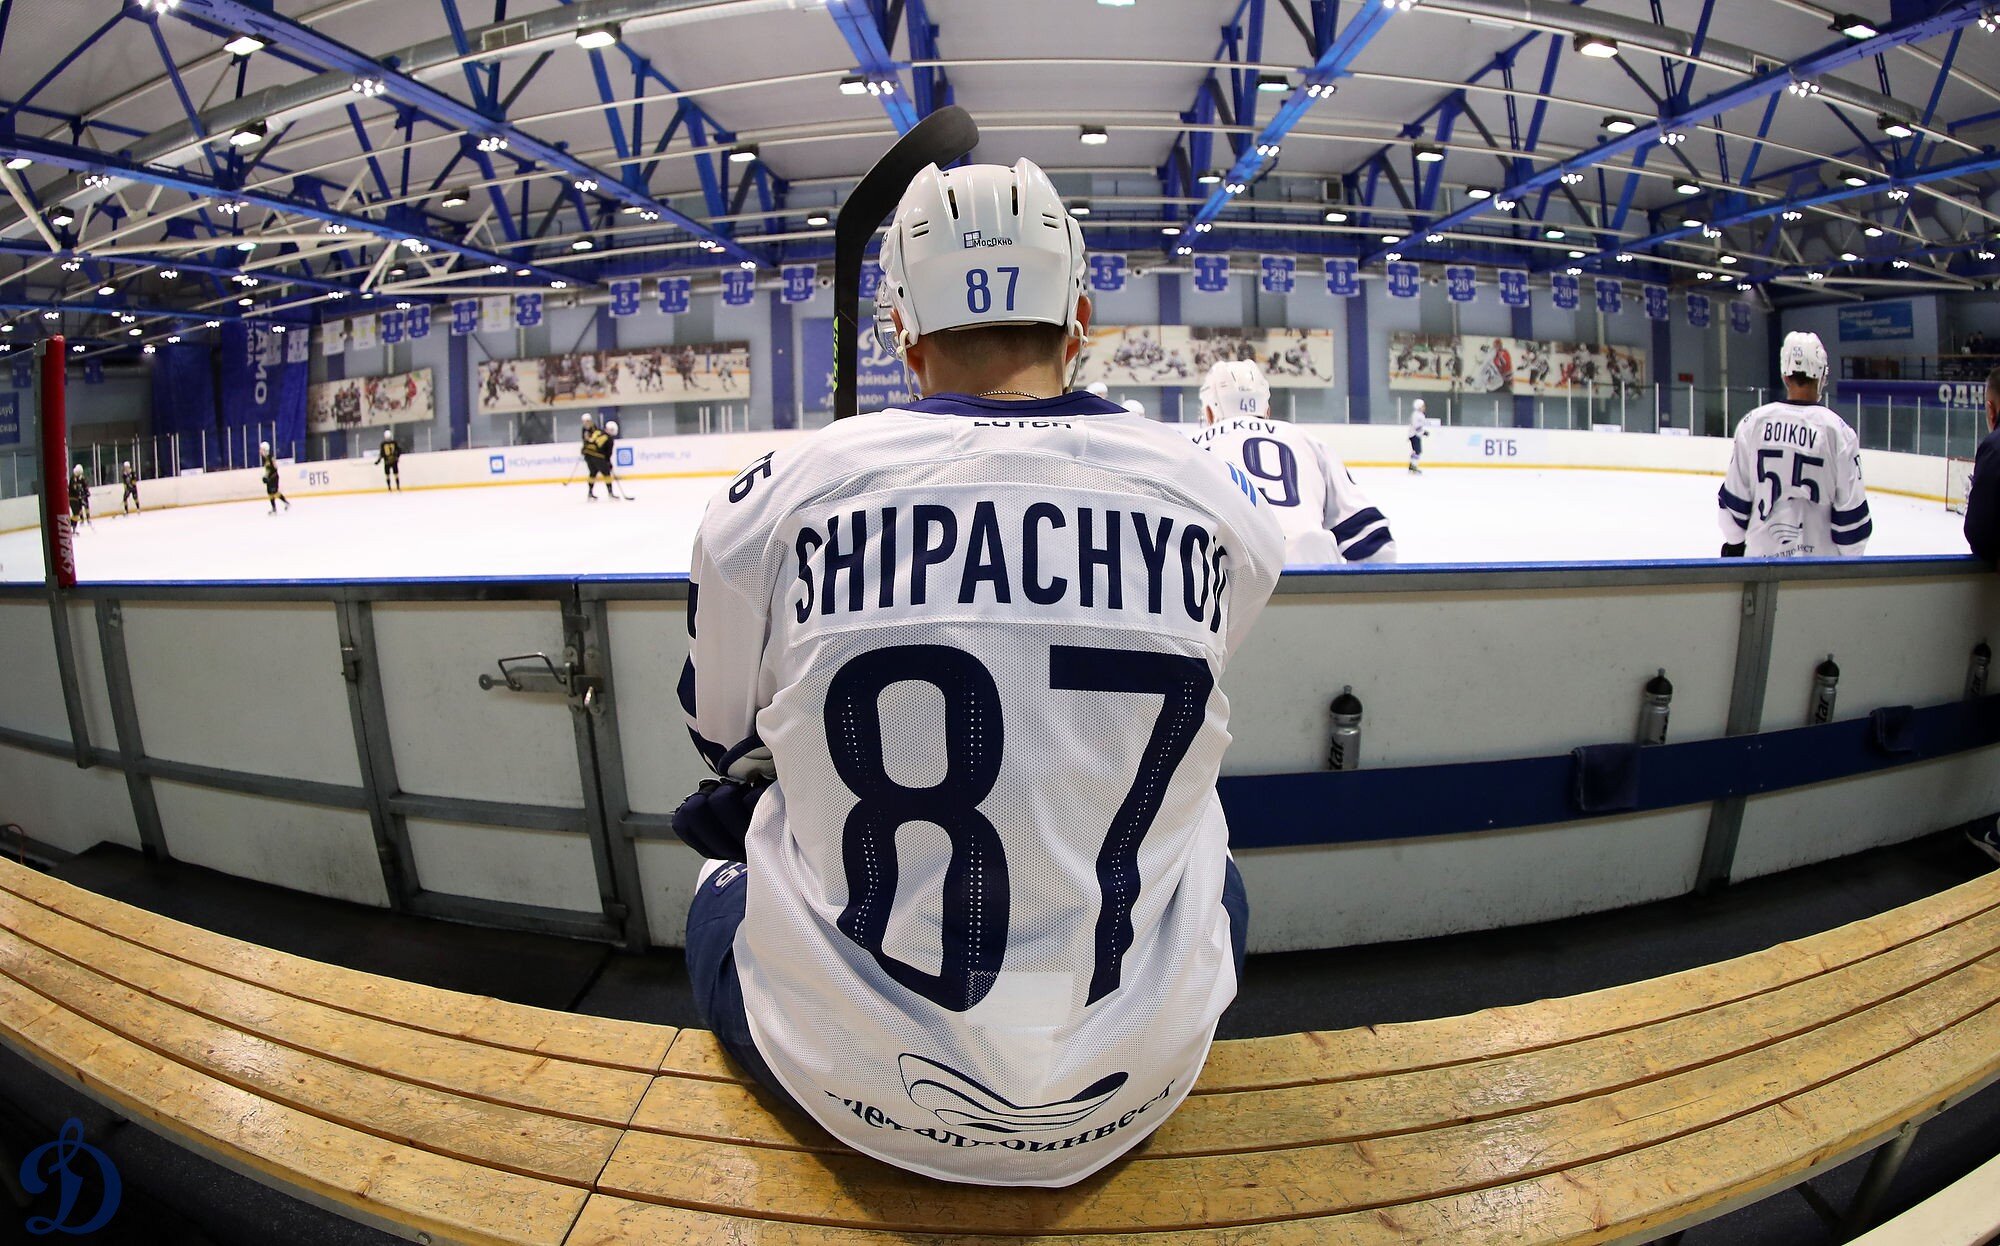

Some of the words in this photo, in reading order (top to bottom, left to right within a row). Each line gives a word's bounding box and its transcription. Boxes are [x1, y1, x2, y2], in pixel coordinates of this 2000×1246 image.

[1103, 265, 1112, 281] 5
[1270, 268, 1287, 283] 29
[1336, 270, 1346, 286] 8
[732, 280, 744, 296] 17
[1399, 274, 1409, 289] 10
[1455, 277, 1469, 292] 26
[965, 266, 1020, 314] 87
[1239, 398, 1257, 413] 49
[1192, 419, 1276, 445] VOLKOV
[1763, 422, 1817, 449] BOIKOV
[1485, 439, 1518, 457] ВТБ
[308, 471, 330, 486] ВТБ
[1757, 449, 1825, 522] 55
[823, 643, 1214, 1013] 87
